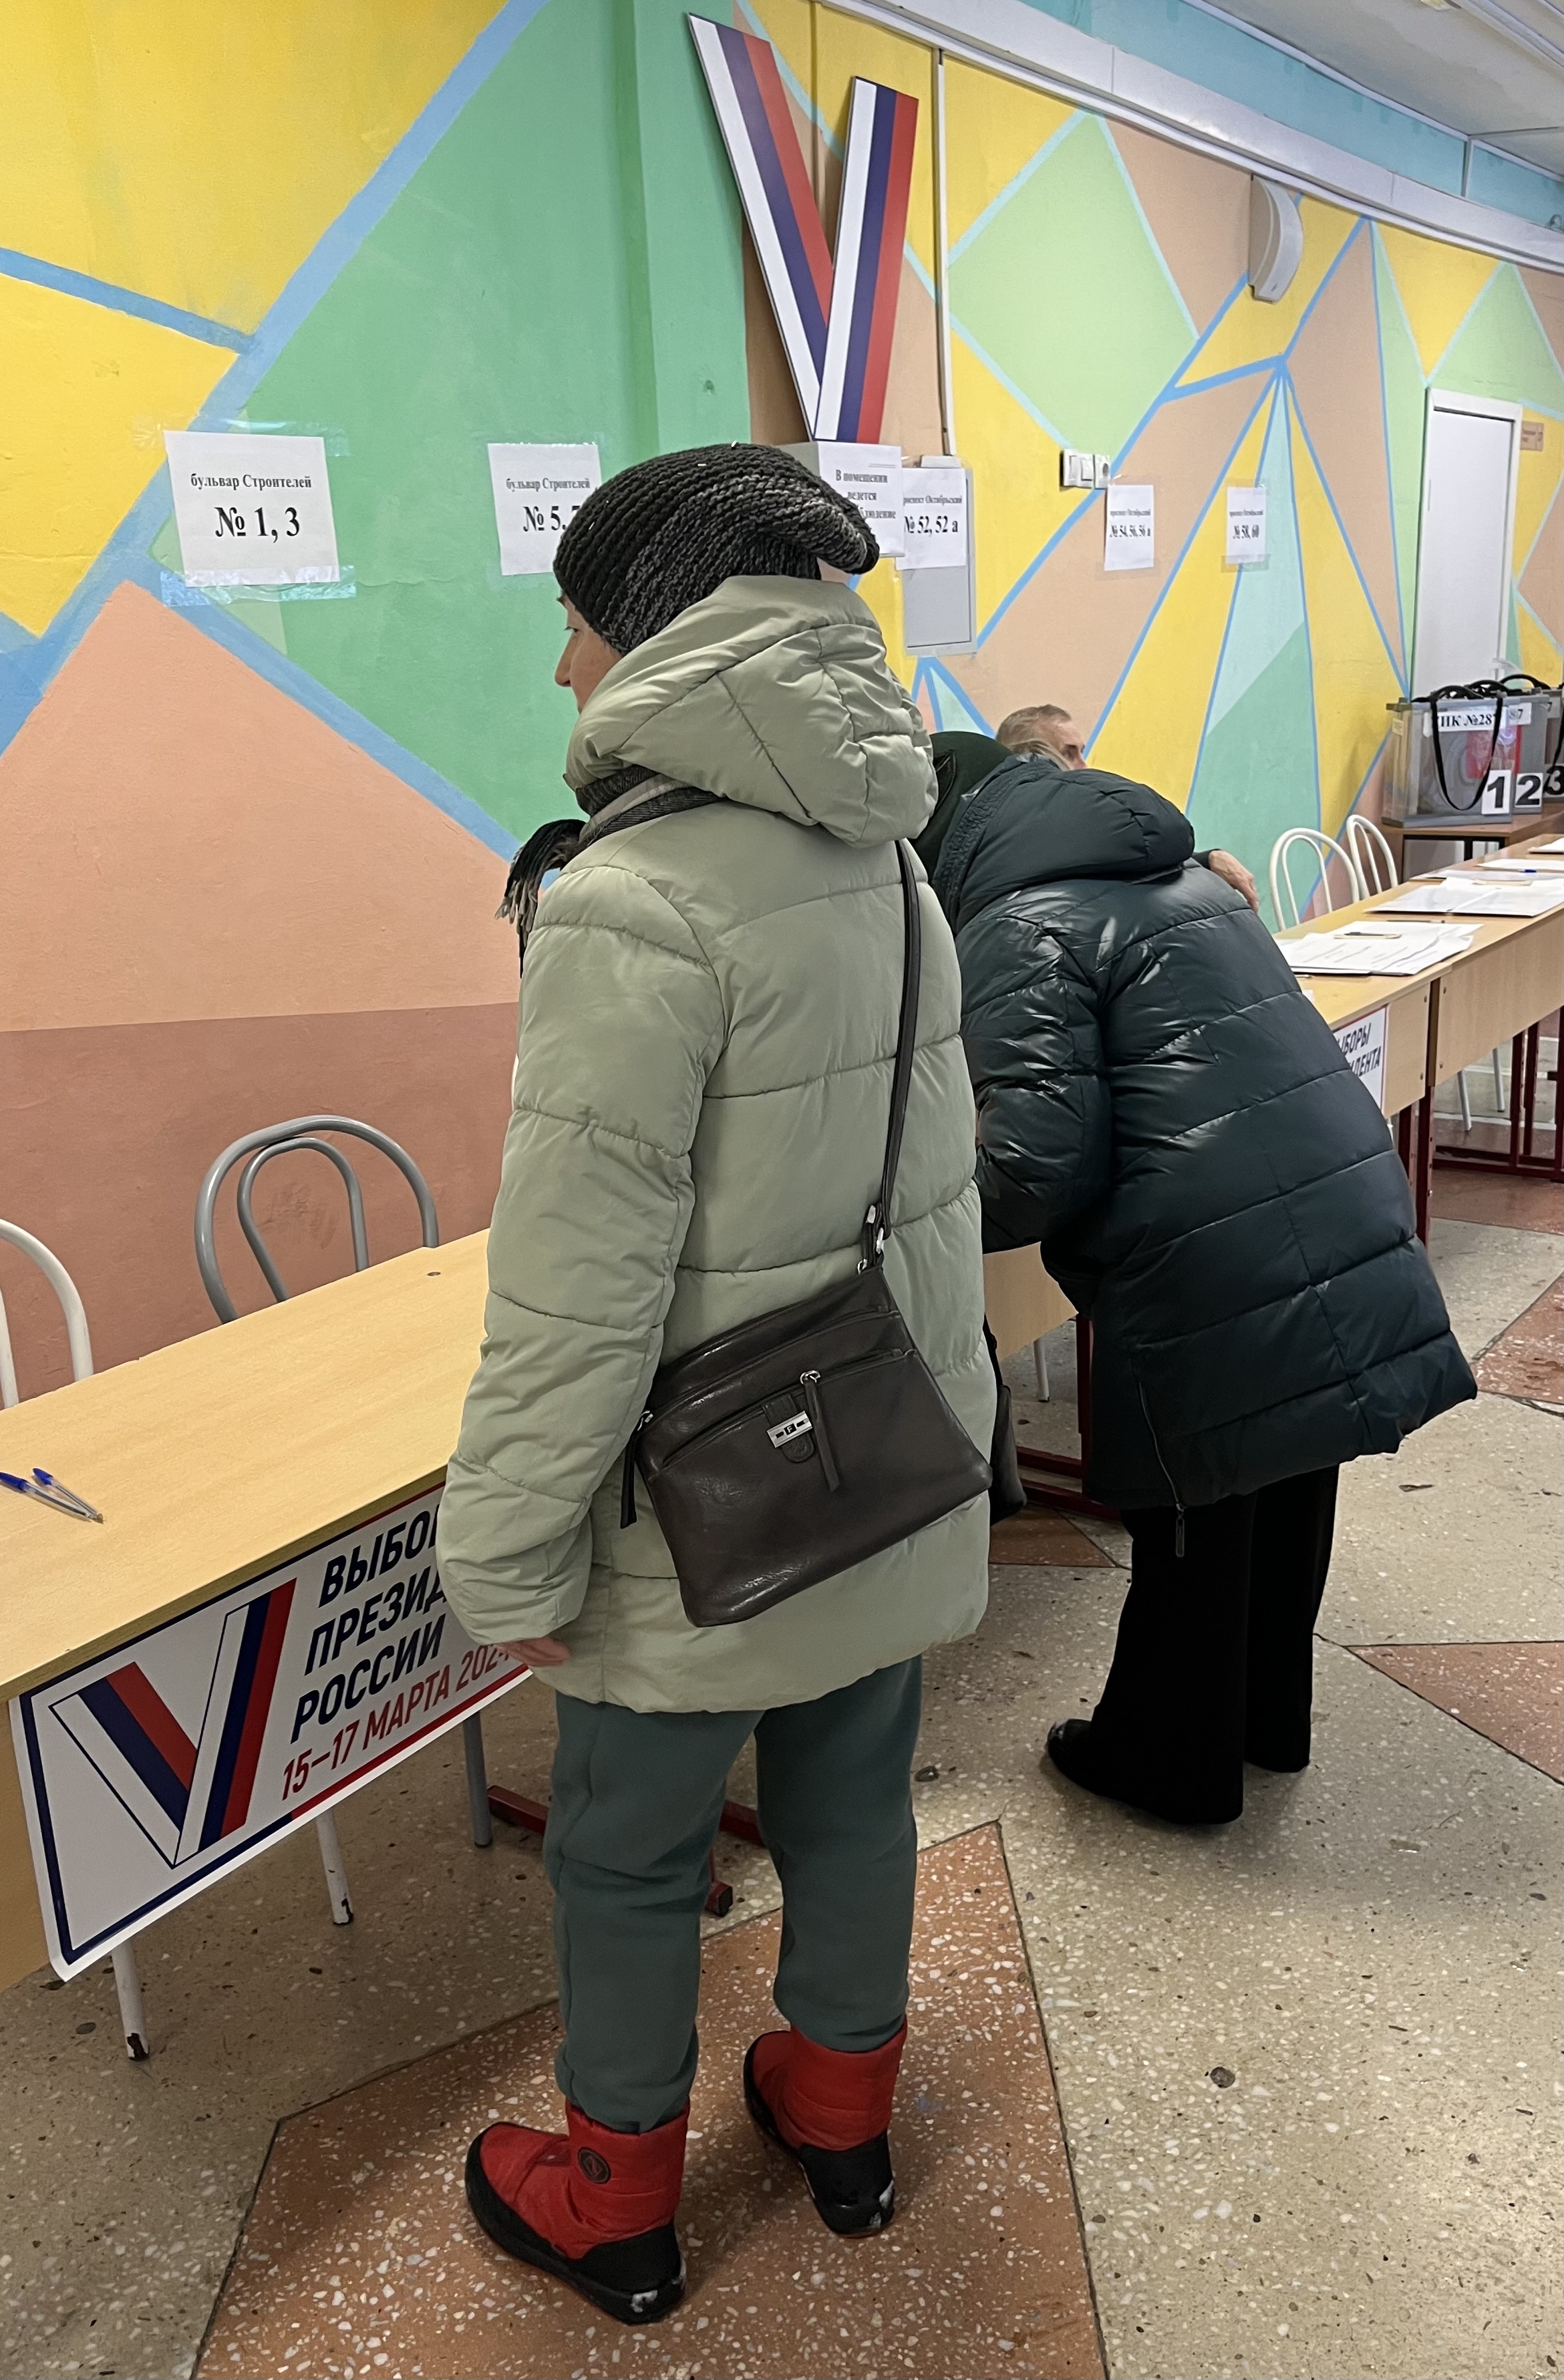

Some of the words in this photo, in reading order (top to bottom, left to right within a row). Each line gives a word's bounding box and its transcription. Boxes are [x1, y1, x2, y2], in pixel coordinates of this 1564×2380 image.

[190, 473, 240, 490] бульвар
[243, 474, 312, 491] Строителей
[214, 506, 247, 537] №
[254, 507, 279, 543] 1,
[285, 506, 301, 537] 3
[522, 506, 544, 532] №
[935, 515, 948, 534] 52
[1464, 713, 1497, 727] №28
[1487, 776, 1505, 809] 1
[1515, 775, 1541, 806] 2
[1543, 766, 1564, 796] 3
[318, 1503, 440, 1608] ВЫБО
[305, 1565, 448, 1677] ПРЕЗИД
[291, 1612, 446, 1744] РОССИИ
[363, 1663, 451, 1749] МАРТА
[456, 1644, 509, 1693] 202
